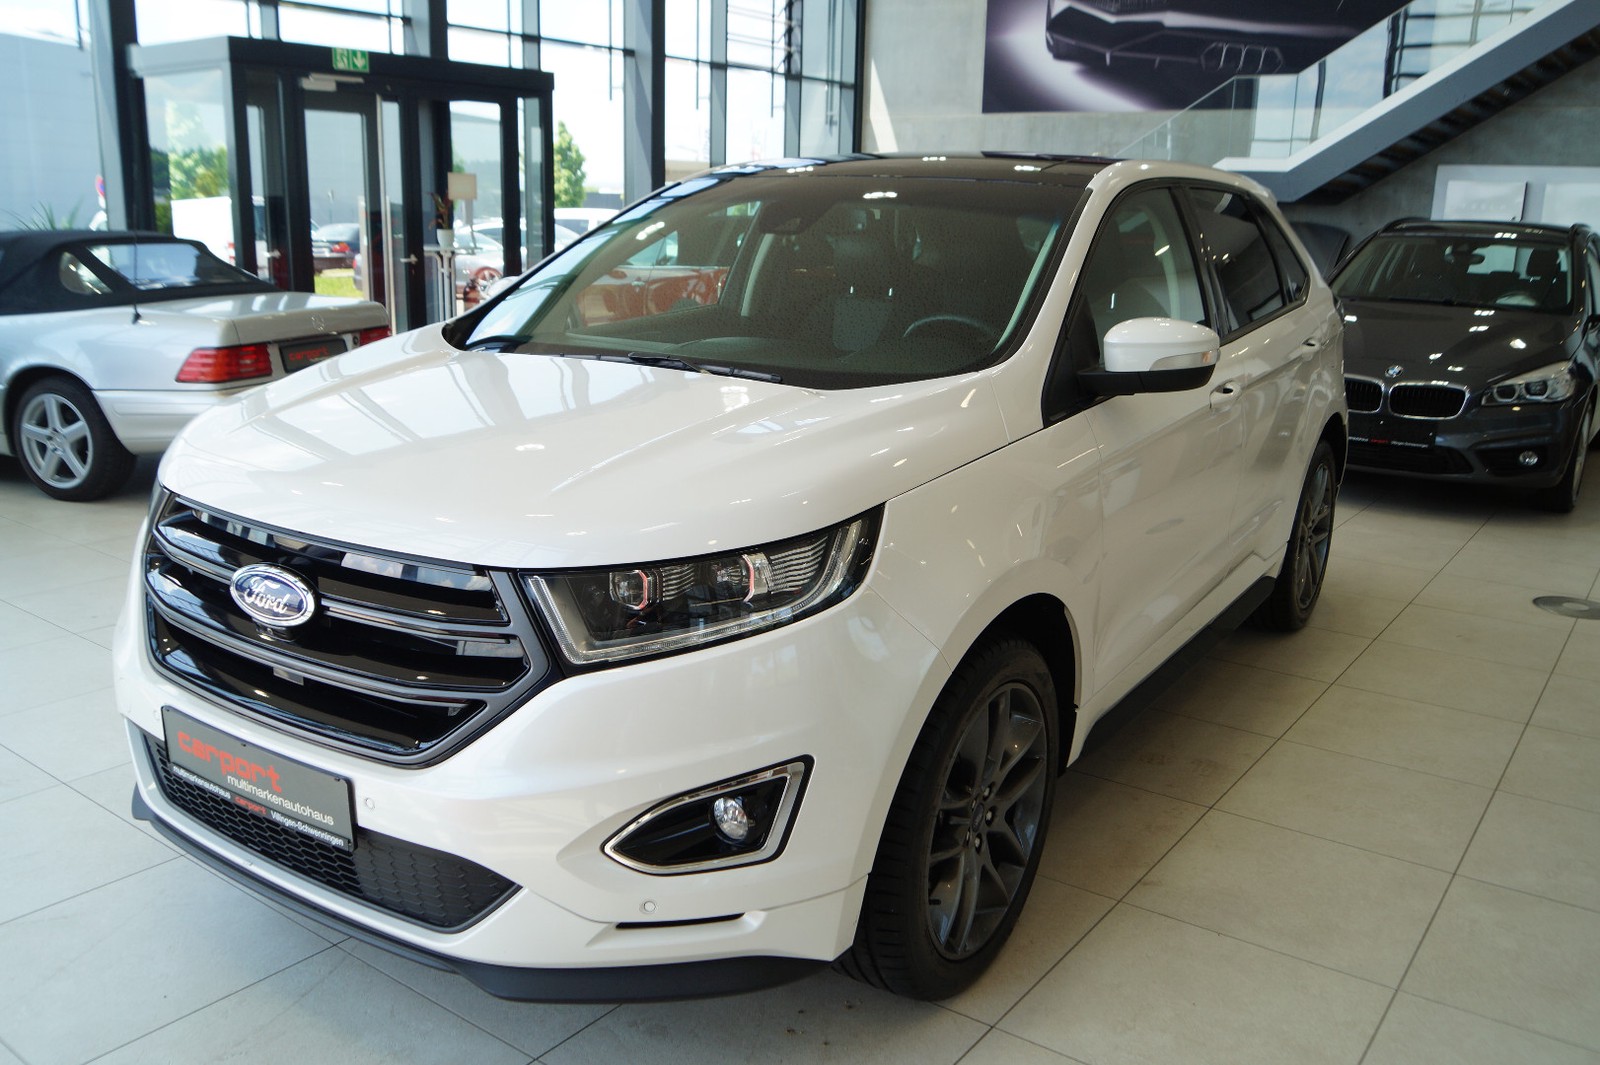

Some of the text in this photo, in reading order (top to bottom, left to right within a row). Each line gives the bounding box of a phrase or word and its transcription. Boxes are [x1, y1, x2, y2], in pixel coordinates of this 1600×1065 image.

[244, 576, 290, 613] Ford
[177, 730, 282, 793] carport
[227, 775, 335, 826] multimarkenautohaus
[234, 796, 267, 815] carport
